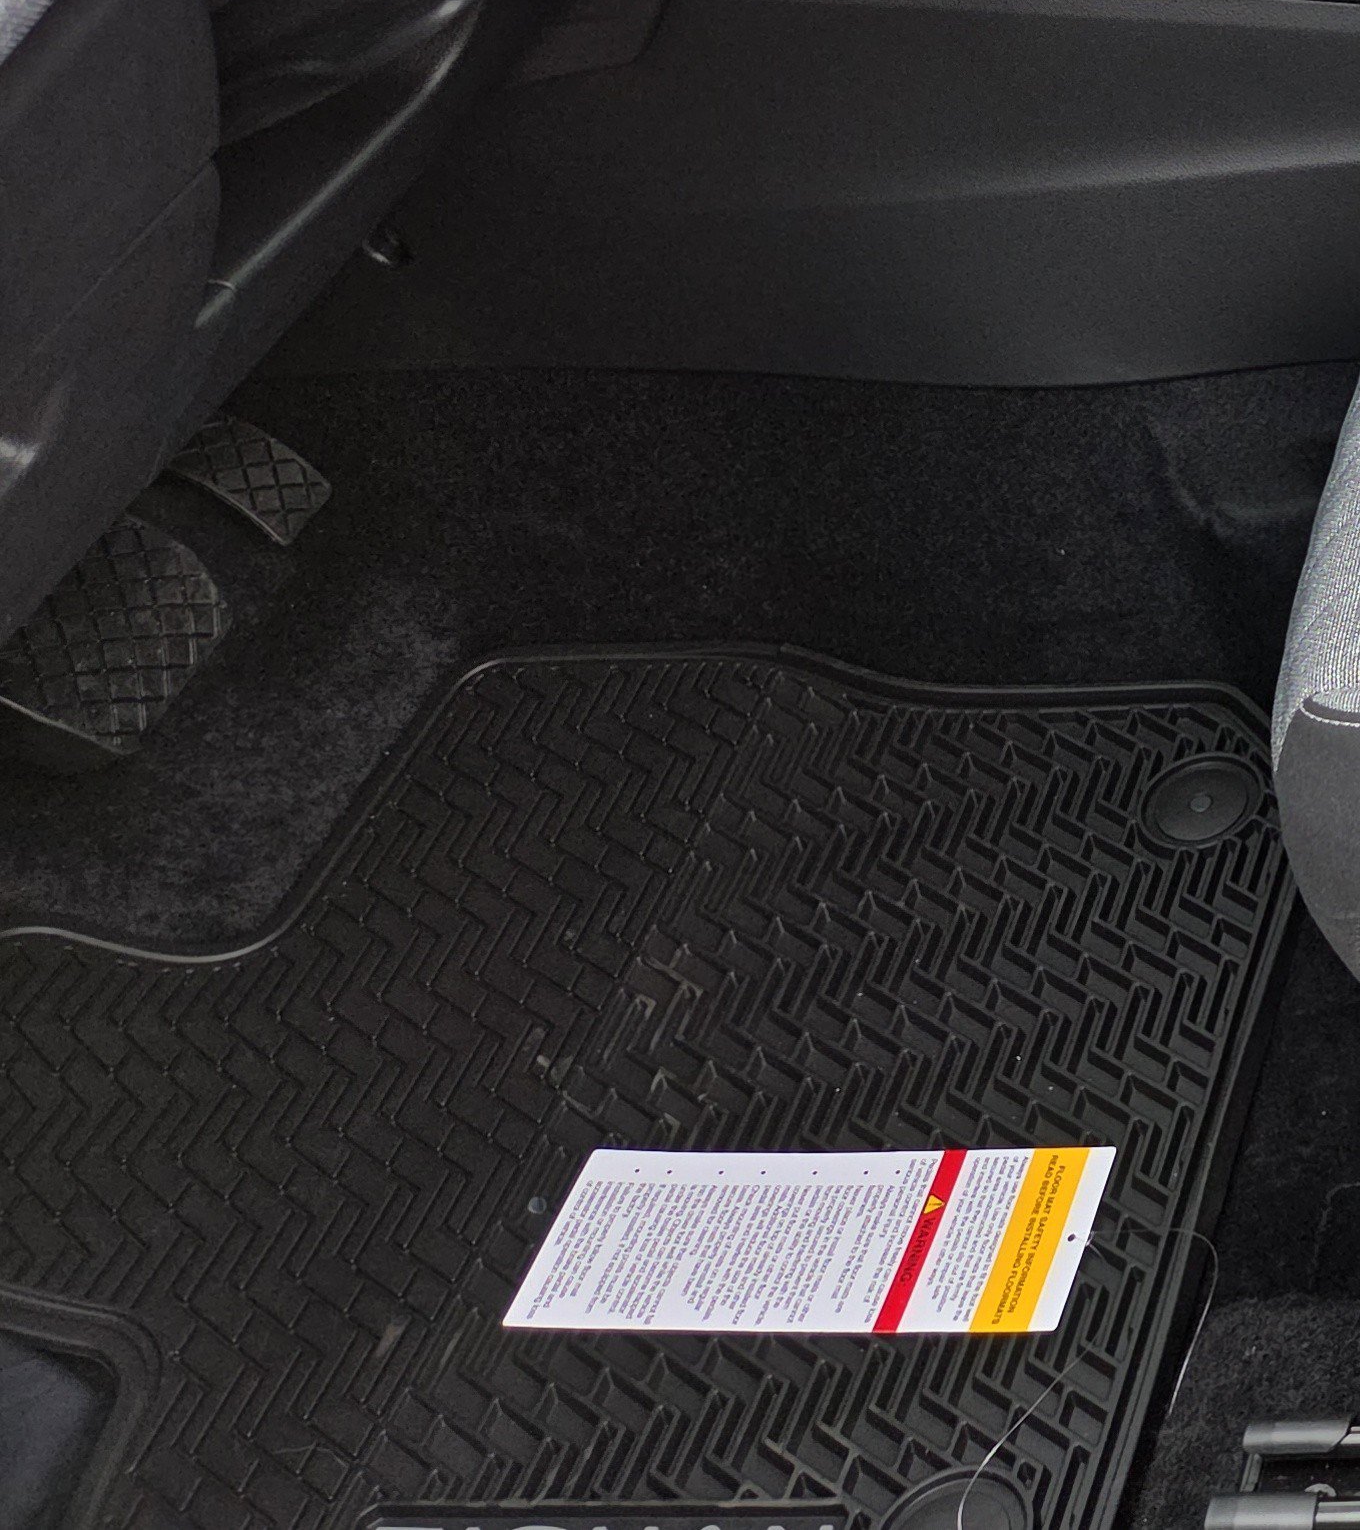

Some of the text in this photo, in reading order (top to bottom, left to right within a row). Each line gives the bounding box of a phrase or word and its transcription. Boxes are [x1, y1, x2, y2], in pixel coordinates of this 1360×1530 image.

[1047, 1165, 1066, 1195] FLOOR
[896, 1216, 937, 1287] WARNING:
[990, 1154, 1059, 1324] READ BEFORE INSTALLING FLOORMATS
[1028, 1215, 1048, 1251] SAFETY
[1006, 1251, 1035, 1312] INFORMATION
